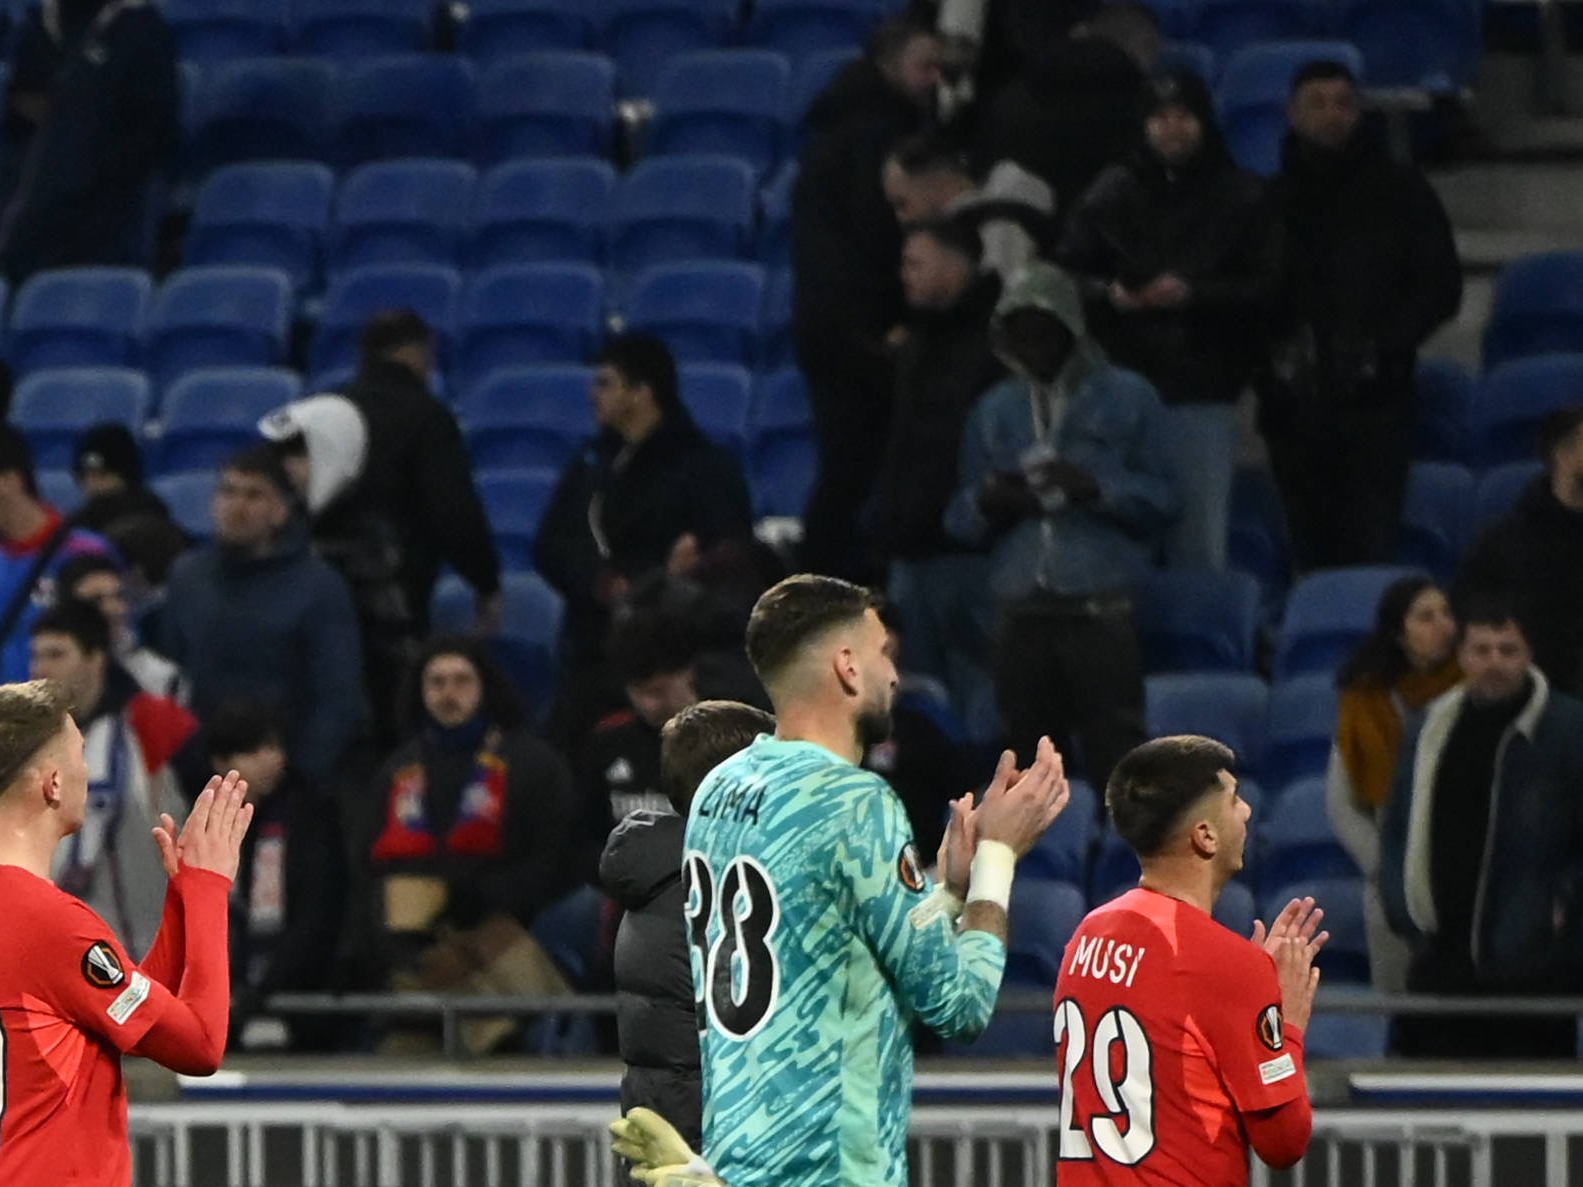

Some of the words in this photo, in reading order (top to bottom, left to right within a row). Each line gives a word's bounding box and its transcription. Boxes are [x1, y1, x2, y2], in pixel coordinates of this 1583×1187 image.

[682, 850, 781, 1042] 38
[1068, 935, 1146, 988] MUSI
[1053, 997, 1158, 1168] 29
